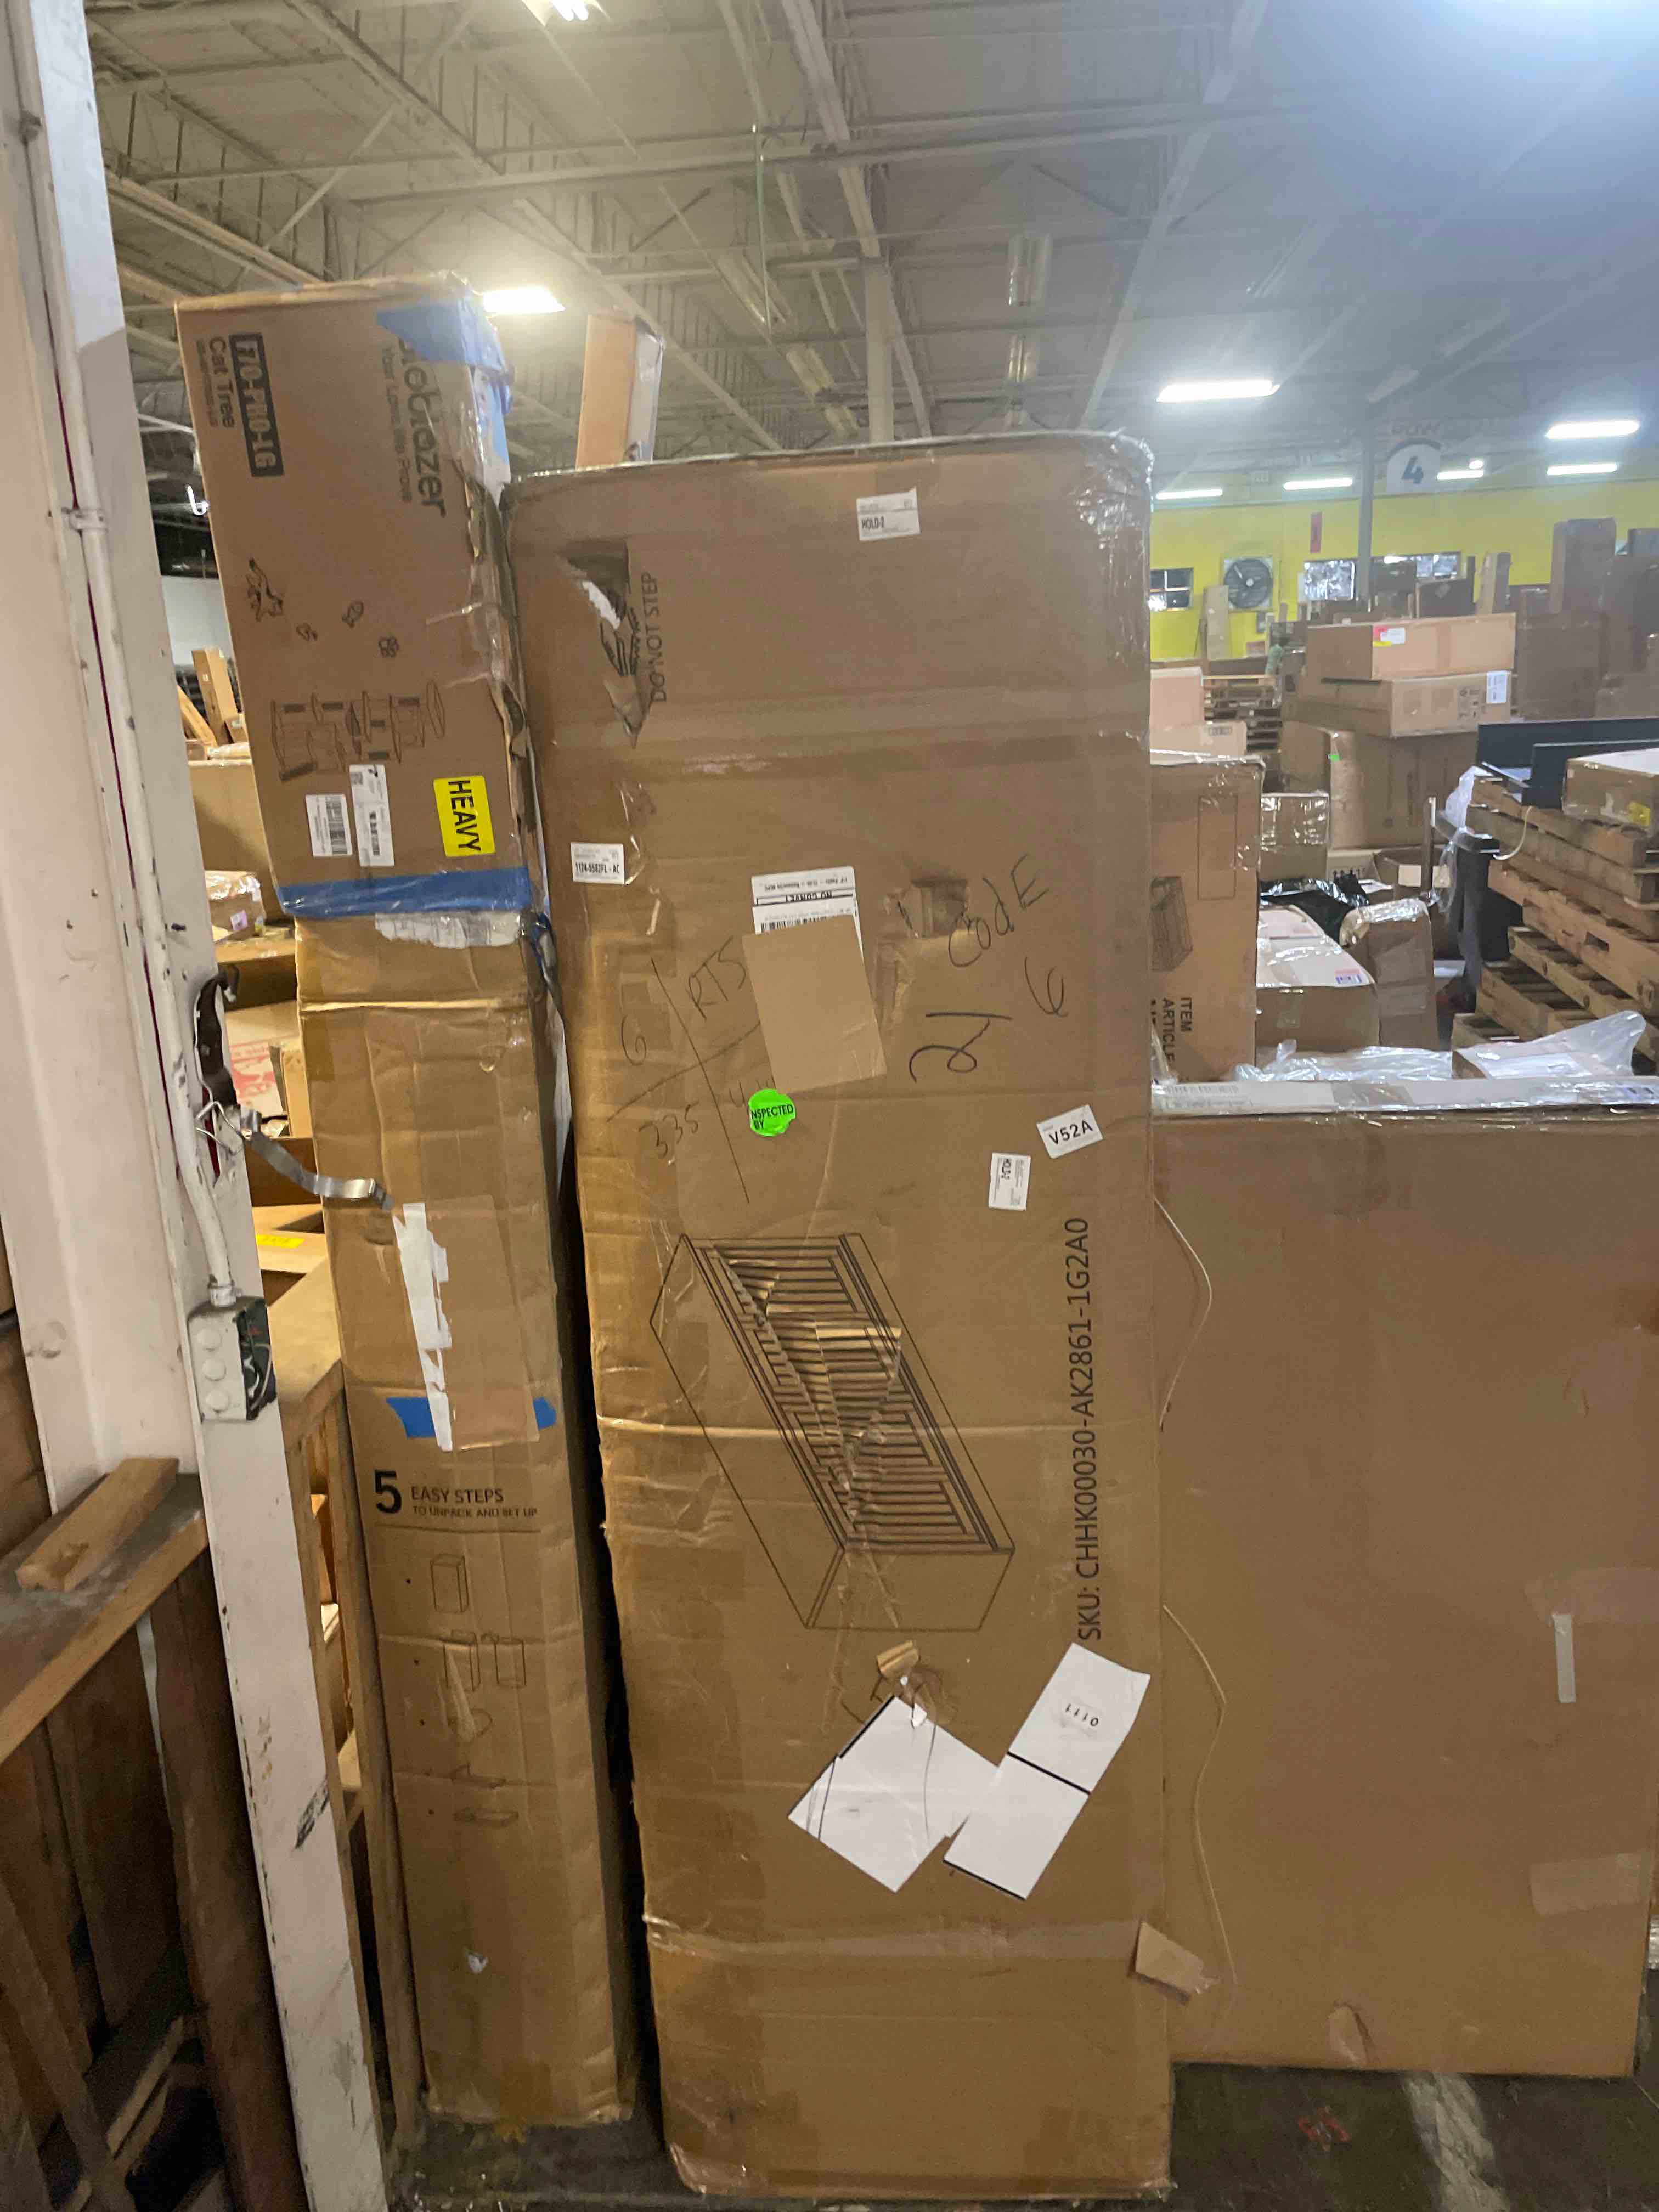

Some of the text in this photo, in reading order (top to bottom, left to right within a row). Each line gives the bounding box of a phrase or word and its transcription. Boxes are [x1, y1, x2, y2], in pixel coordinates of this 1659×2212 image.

[209, 336, 235, 428] Cat Tree
[400, 340, 447, 517] loblazer
[1401, 455, 1424, 484] 4
[640, 571, 667, 703] DO NOT STEP
[447, 780, 482, 852] HEAVY
[1161, 1000, 1176, 1061] ARTICLE
[1180, 997, 1193, 1032] ITEM
[751, 1103, 794, 1118] NSPECTED
[754, 1119, 765, 1129] BY
[1048, 1120, 1093, 1145] V52A
[1064, 1216, 1102, 1641] SKU: CHHK00030-AK2861-1G2A0
[374, 1470, 504, 1514] 5 EASY STEPS
[413, 1505, 427, 1516] TO
[476, 1508, 499, 1519] AND
[524, 1508, 537, 1518] UP
